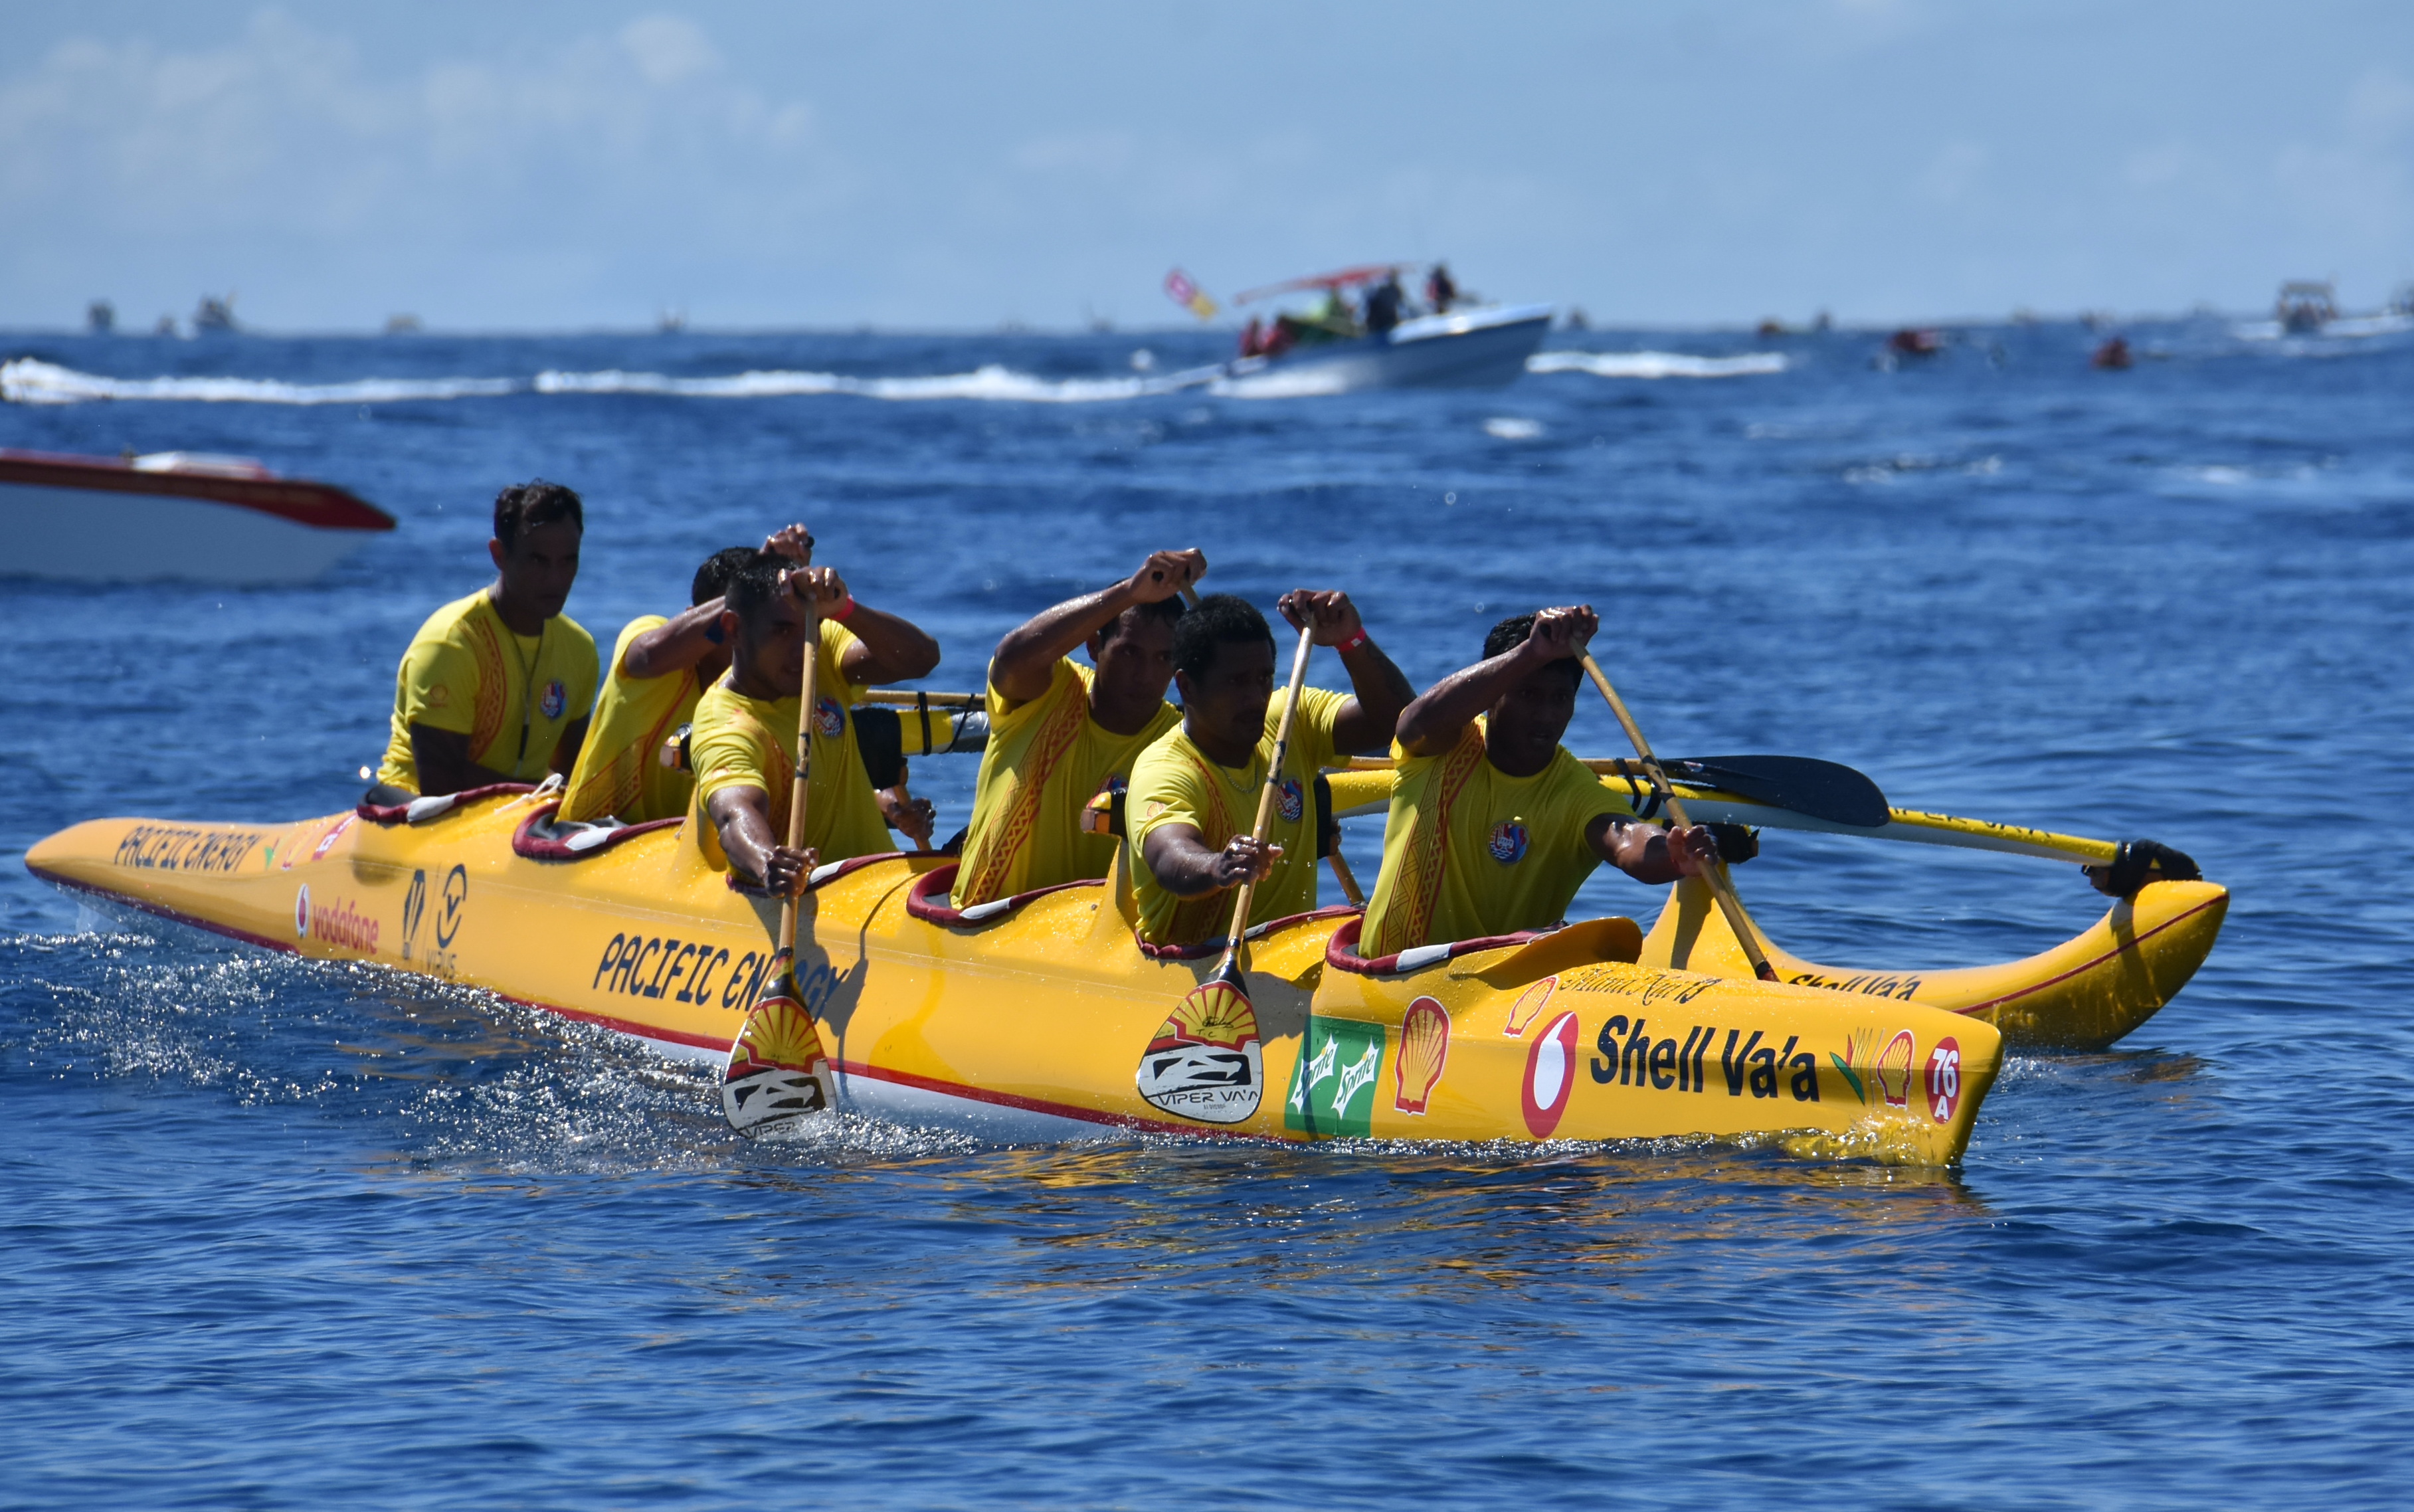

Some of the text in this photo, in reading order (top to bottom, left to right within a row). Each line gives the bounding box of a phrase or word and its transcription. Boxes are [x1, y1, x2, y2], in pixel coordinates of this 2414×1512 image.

[114, 826, 201, 870] PACIFIC
[184, 832, 264, 872] ENERGY
[313, 896, 379, 955] vodafone
[593, 932, 850, 1025] PACIFIC ENRGY
[1295, 1047, 1334, 1099] Sprite
[1337, 1052, 1375, 1104] Sprite
[1590, 1014, 1820, 1103] Shell Va'a
[1932, 1048, 1958, 1098] 76
[1158, 1091, 1214, 1106] VIPER
[1934, 1095, 1949, 1120] A
